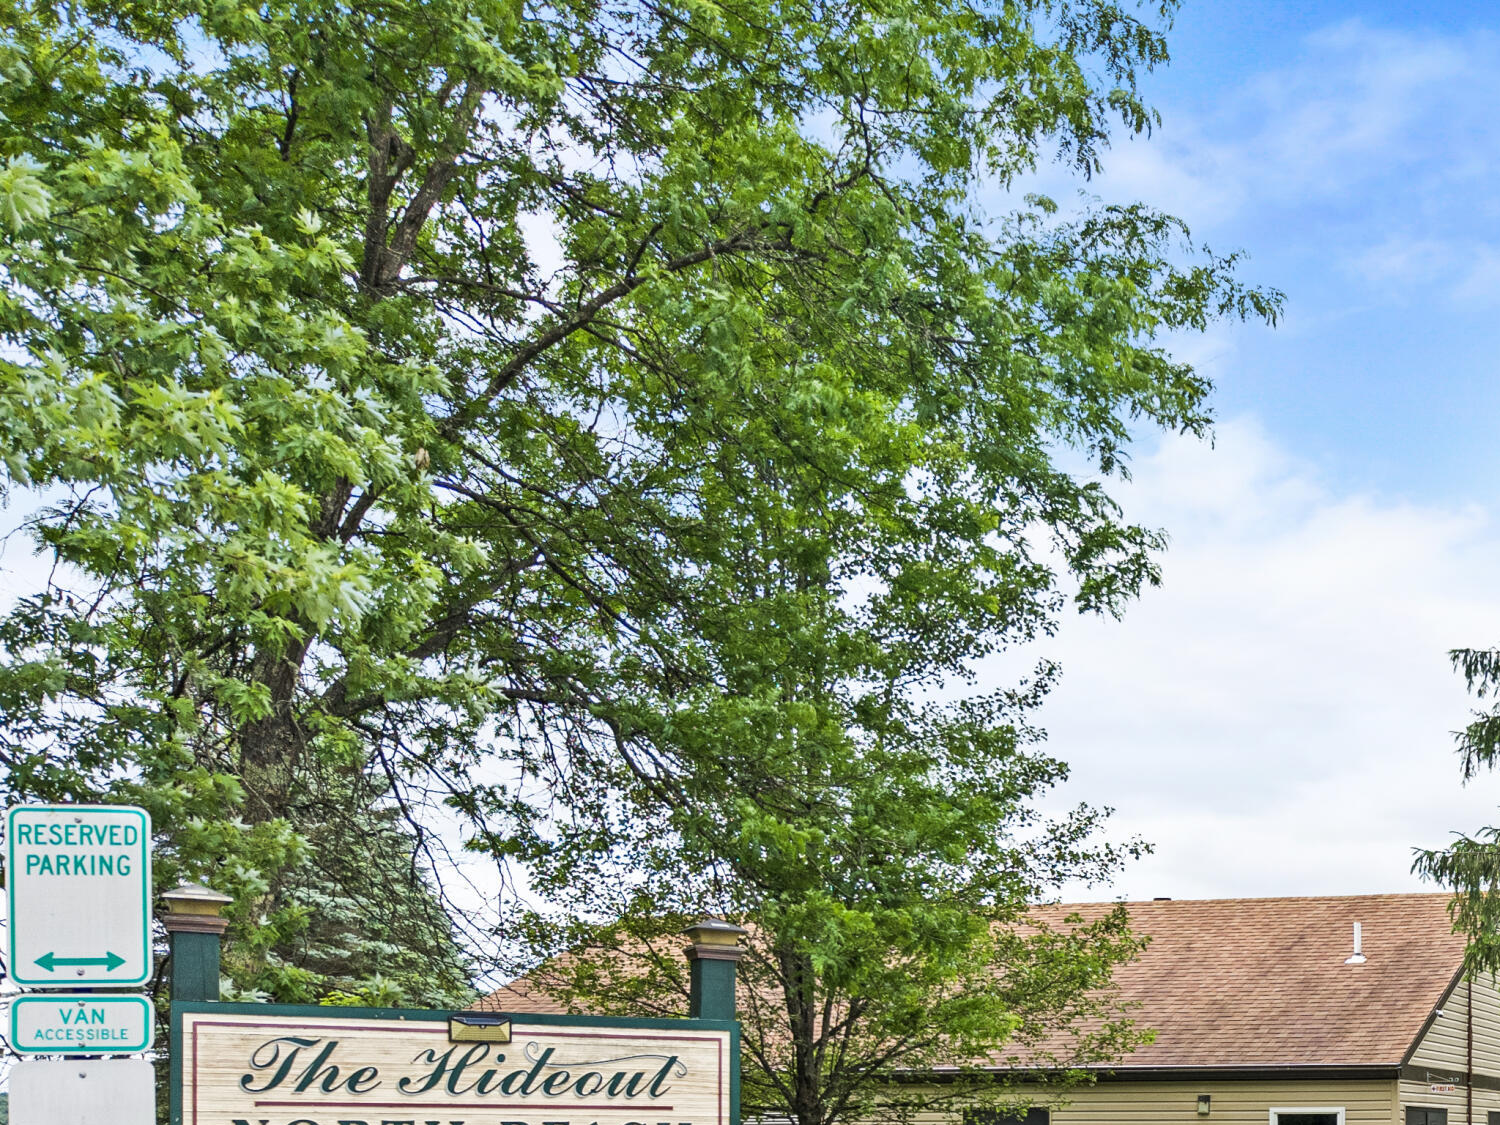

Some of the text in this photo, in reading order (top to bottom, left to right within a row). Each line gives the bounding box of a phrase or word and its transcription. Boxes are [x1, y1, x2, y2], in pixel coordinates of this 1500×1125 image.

[17, 824, 138, 846] RESERVED
[25, 854, 131, 877] PARKING
[59, 1008, 105, 1025] VAN
[33, 1028, 129, 1041] ACCESSIBLE
[239, 1036, 688, 1100] The Hideout
